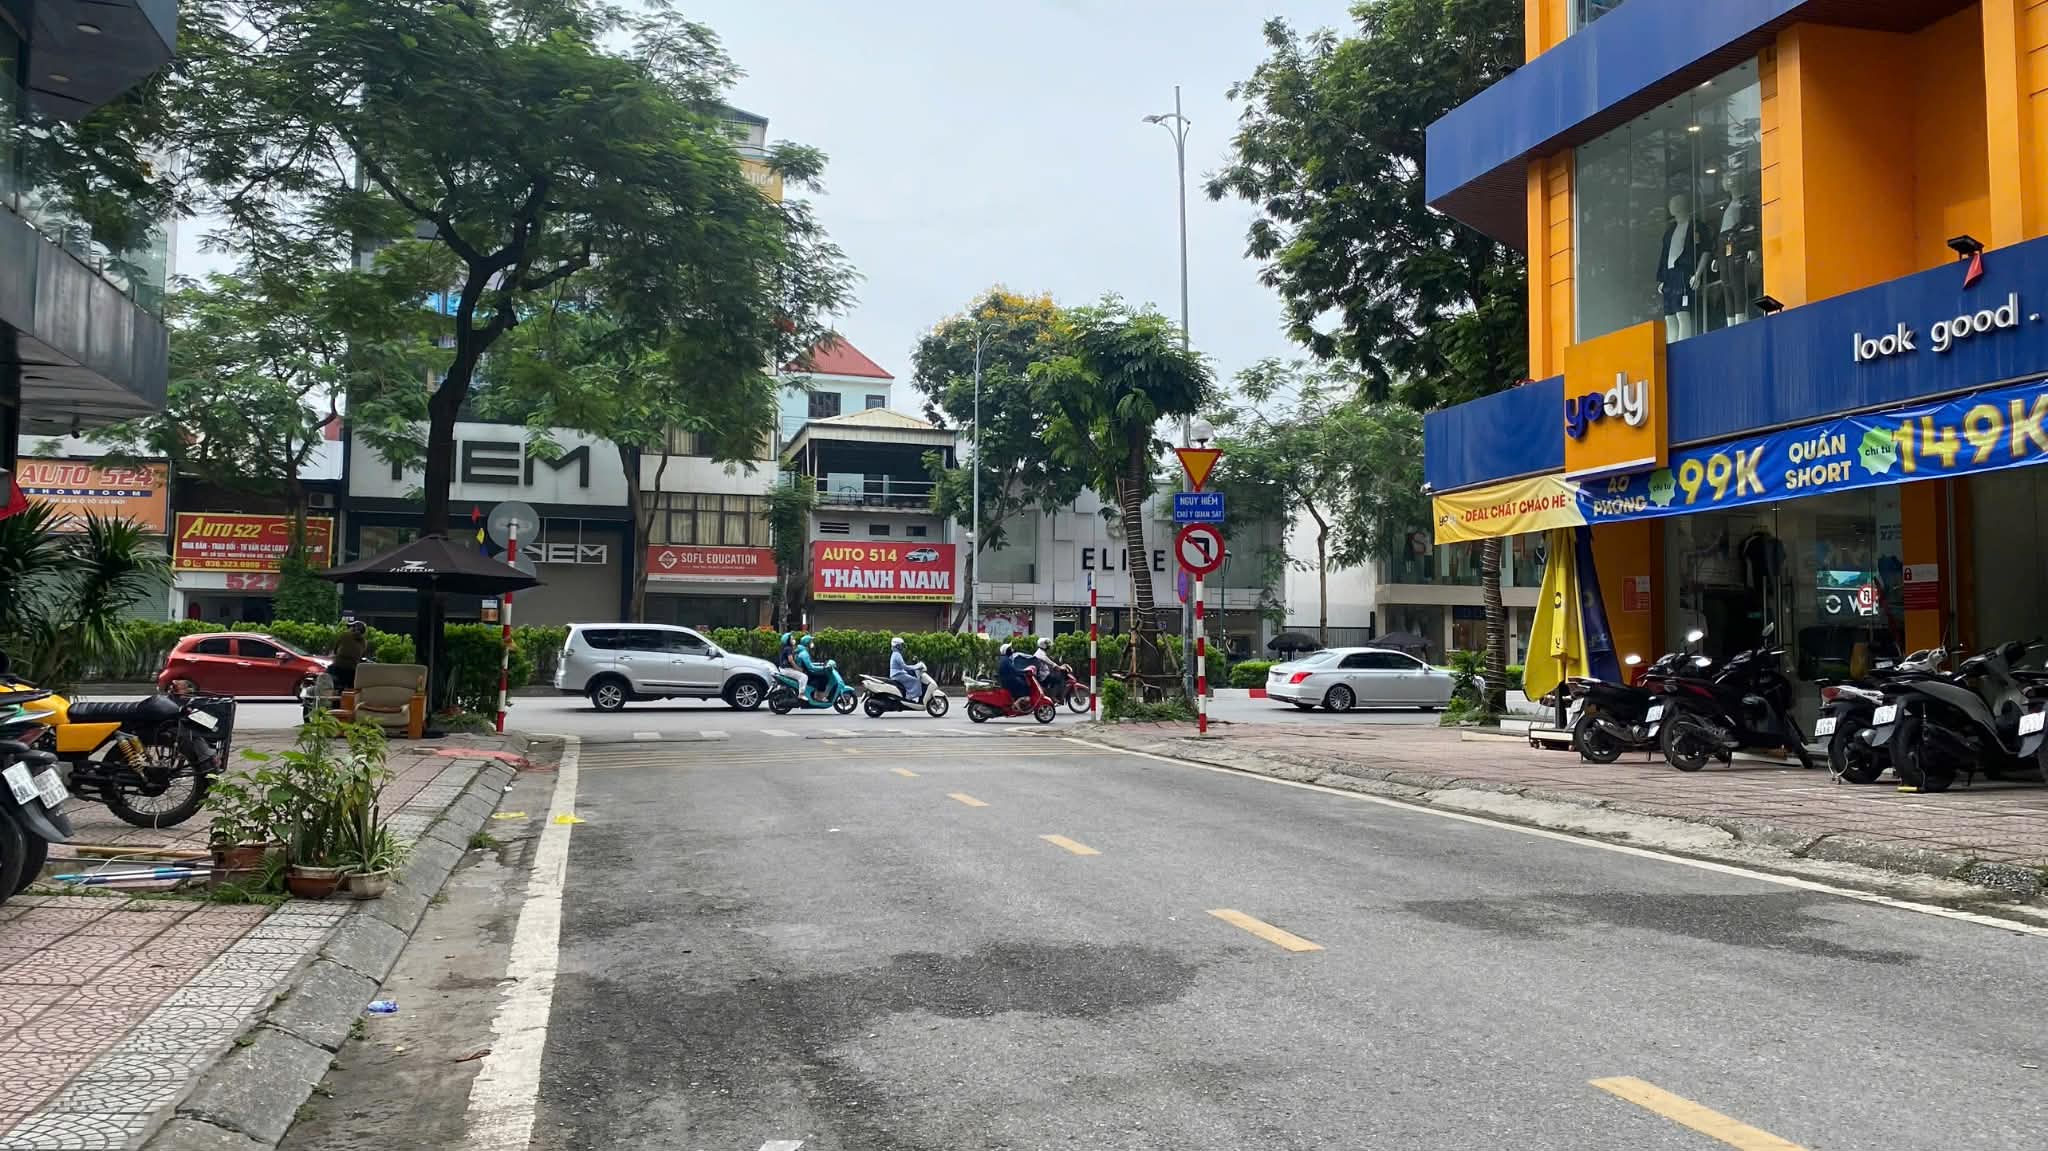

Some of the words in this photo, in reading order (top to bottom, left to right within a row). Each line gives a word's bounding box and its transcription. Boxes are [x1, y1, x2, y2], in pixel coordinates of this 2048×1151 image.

[1854, 322, 1917, 362] look
[1565, 371, 1648, 439] yody
[1892, 393, 2048, 473] 149K
[16, 463, 92, 486] AUTO
[100, 465, 154, 488] 524
[1678, 445, 1767, 505] 99K
[1785, 460, 1852, 490] SHORT
[28, 488, 141, 497] SHOWROOM
[182, 516, 233, 539] AUTO
[232, 524, 263, 538] 522
[1465, 508, 1489, 522] DEAL
[681, 552, 704, 563] SOFL
[707, 553, 757, 565] EDUCATION
[821, 547, 865, 561] AUTO
[869, 548, 898, 562] 514
[1082, 547, 1166, 572] ELIE
[821, 565, 894, 589] THÀNH
[900, 570, 950, 590] NAM
